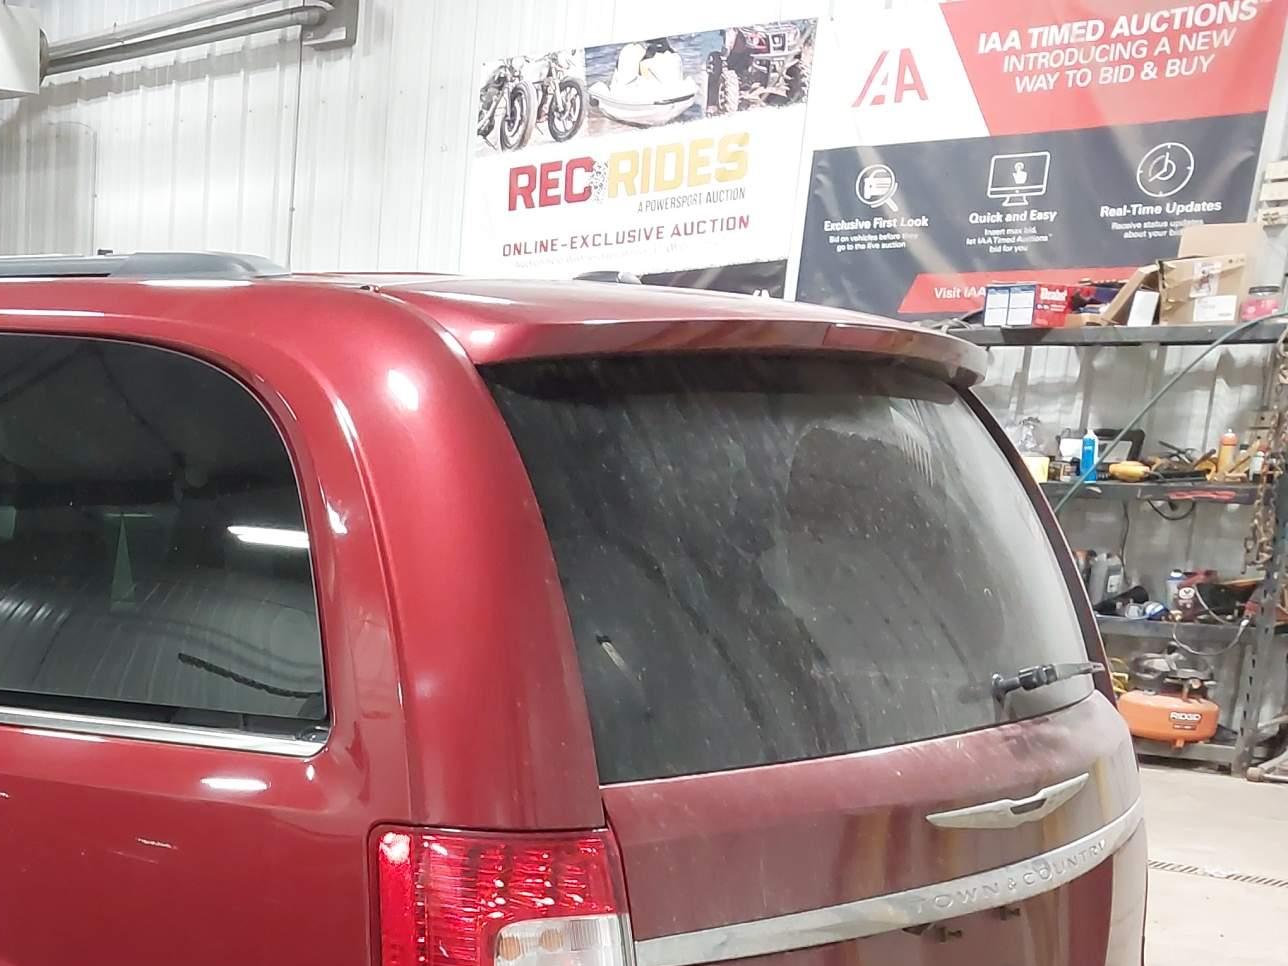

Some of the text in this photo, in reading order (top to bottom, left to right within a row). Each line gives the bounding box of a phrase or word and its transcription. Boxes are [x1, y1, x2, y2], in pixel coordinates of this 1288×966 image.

[978, 0, 1259, 54] IAA TIMED AUCTIONS
[1003, 27, 1237, 73] INTRODUCING A NEW
[1015, 53, 1215, 94] WAY TO BID & BUY
[508, 131, 750, 211] REC RIDES
[637, 187, 746, 214] A POWERSPORT AUCTION
[968, 209, 1058, 224] Quick and Easy
[1100, 201, 1222, 217] Real-Time Updates
[502, 226, 664, 257] ONLINE-EXCLUSIVE
[670, 214, 750, 238] AUCTION
[824, 215, 929, 232] Exclusive First Look
[934, 287, 961, 299] Visit
[910, 882, 1000, 914] TOWN
[1023, 839, 1106, 886] COUNTRY
